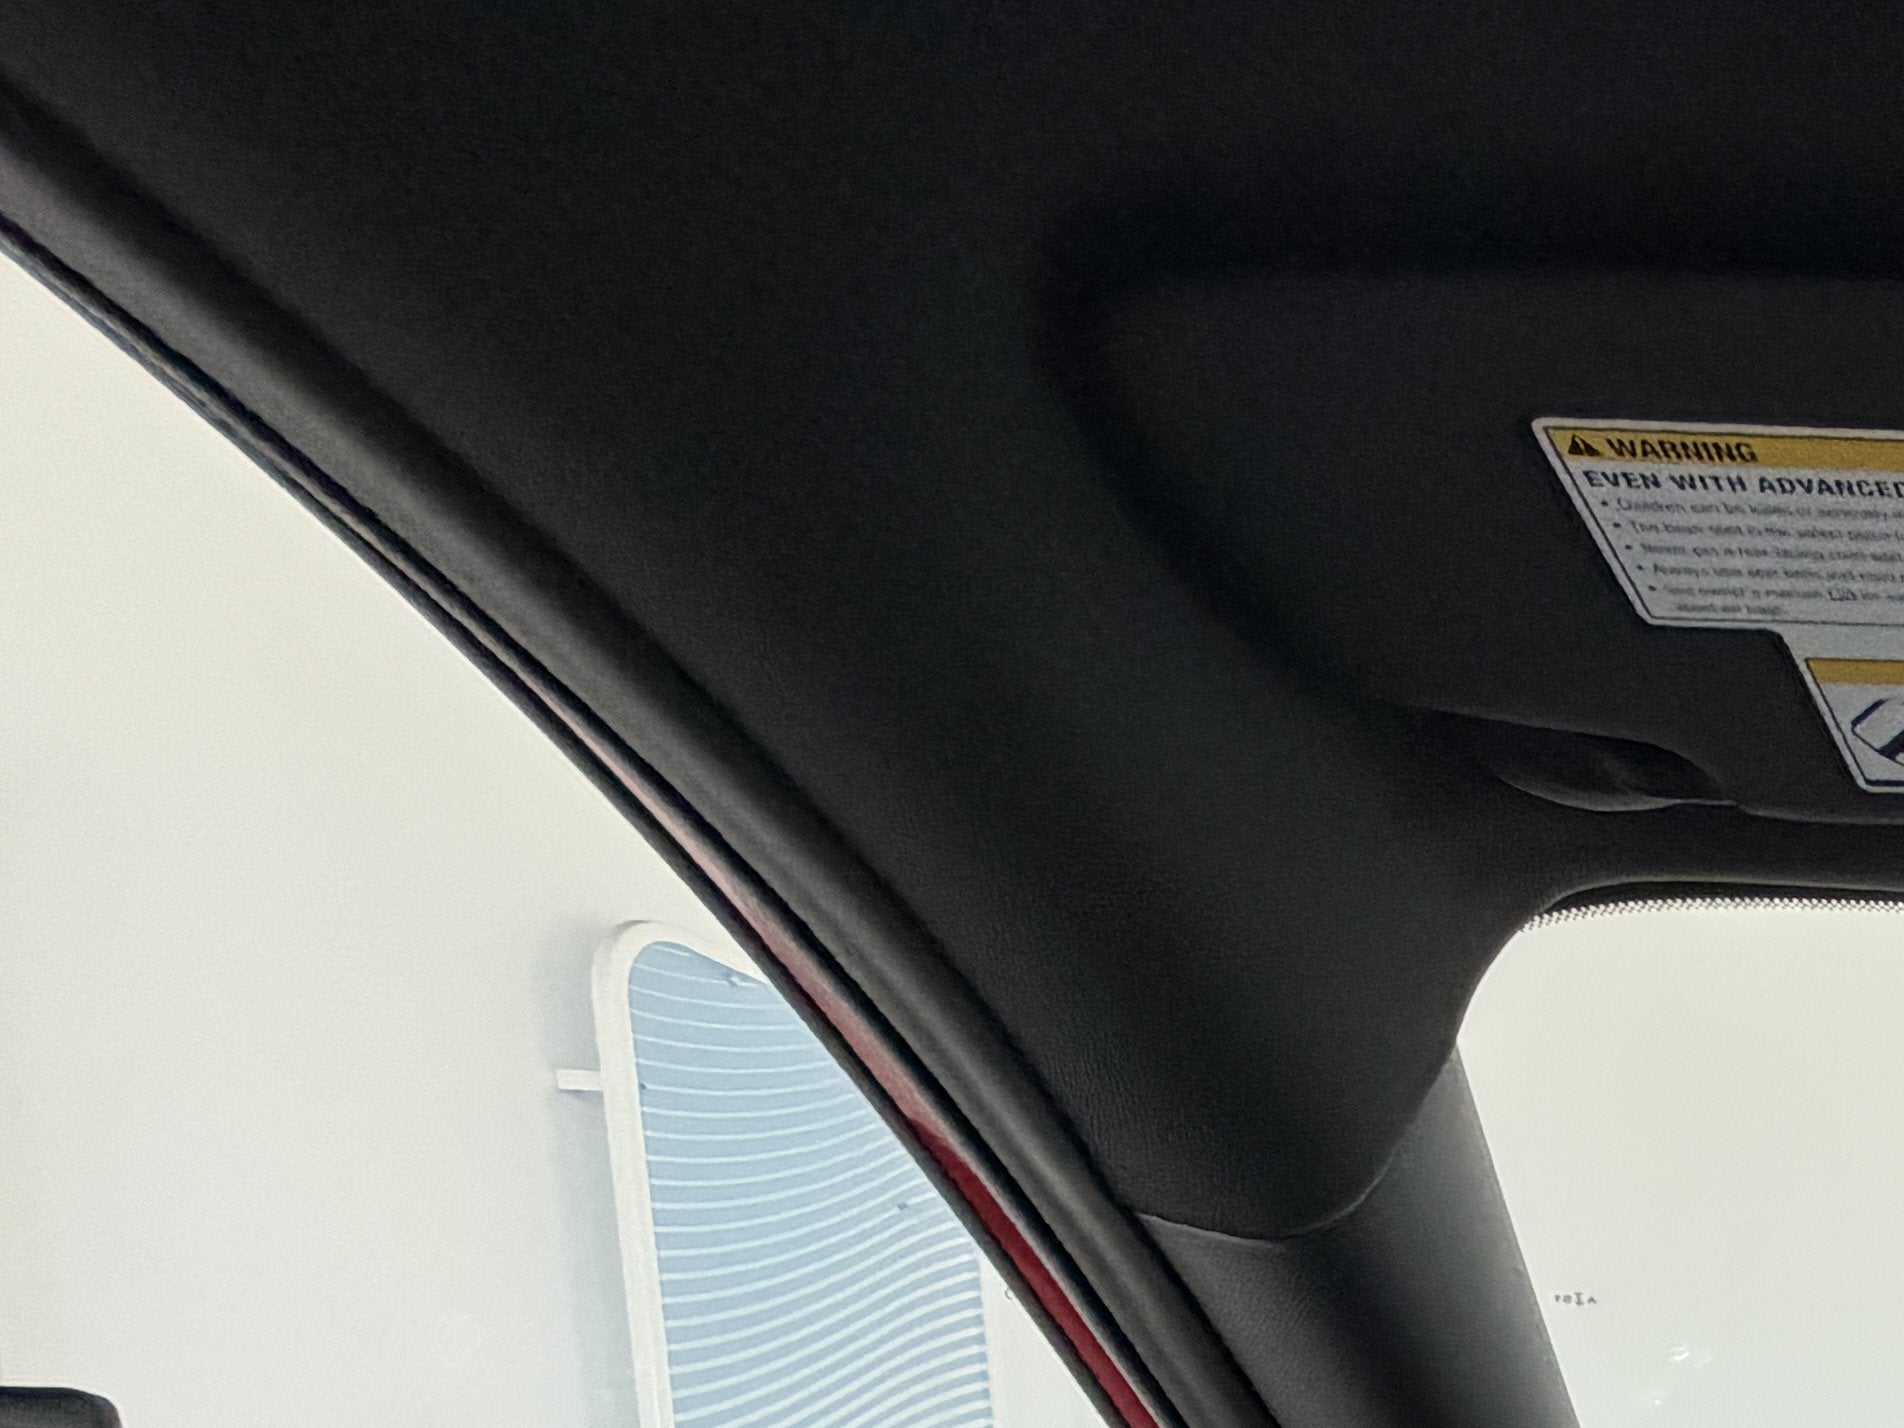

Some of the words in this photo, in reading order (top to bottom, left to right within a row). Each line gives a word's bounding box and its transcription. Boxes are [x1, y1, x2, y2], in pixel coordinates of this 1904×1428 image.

[1604, 438, 1759, 463] WARNING
[1583, 470, 1661, 490] EVEN
[1668, 474, 1748, 493] WITH
